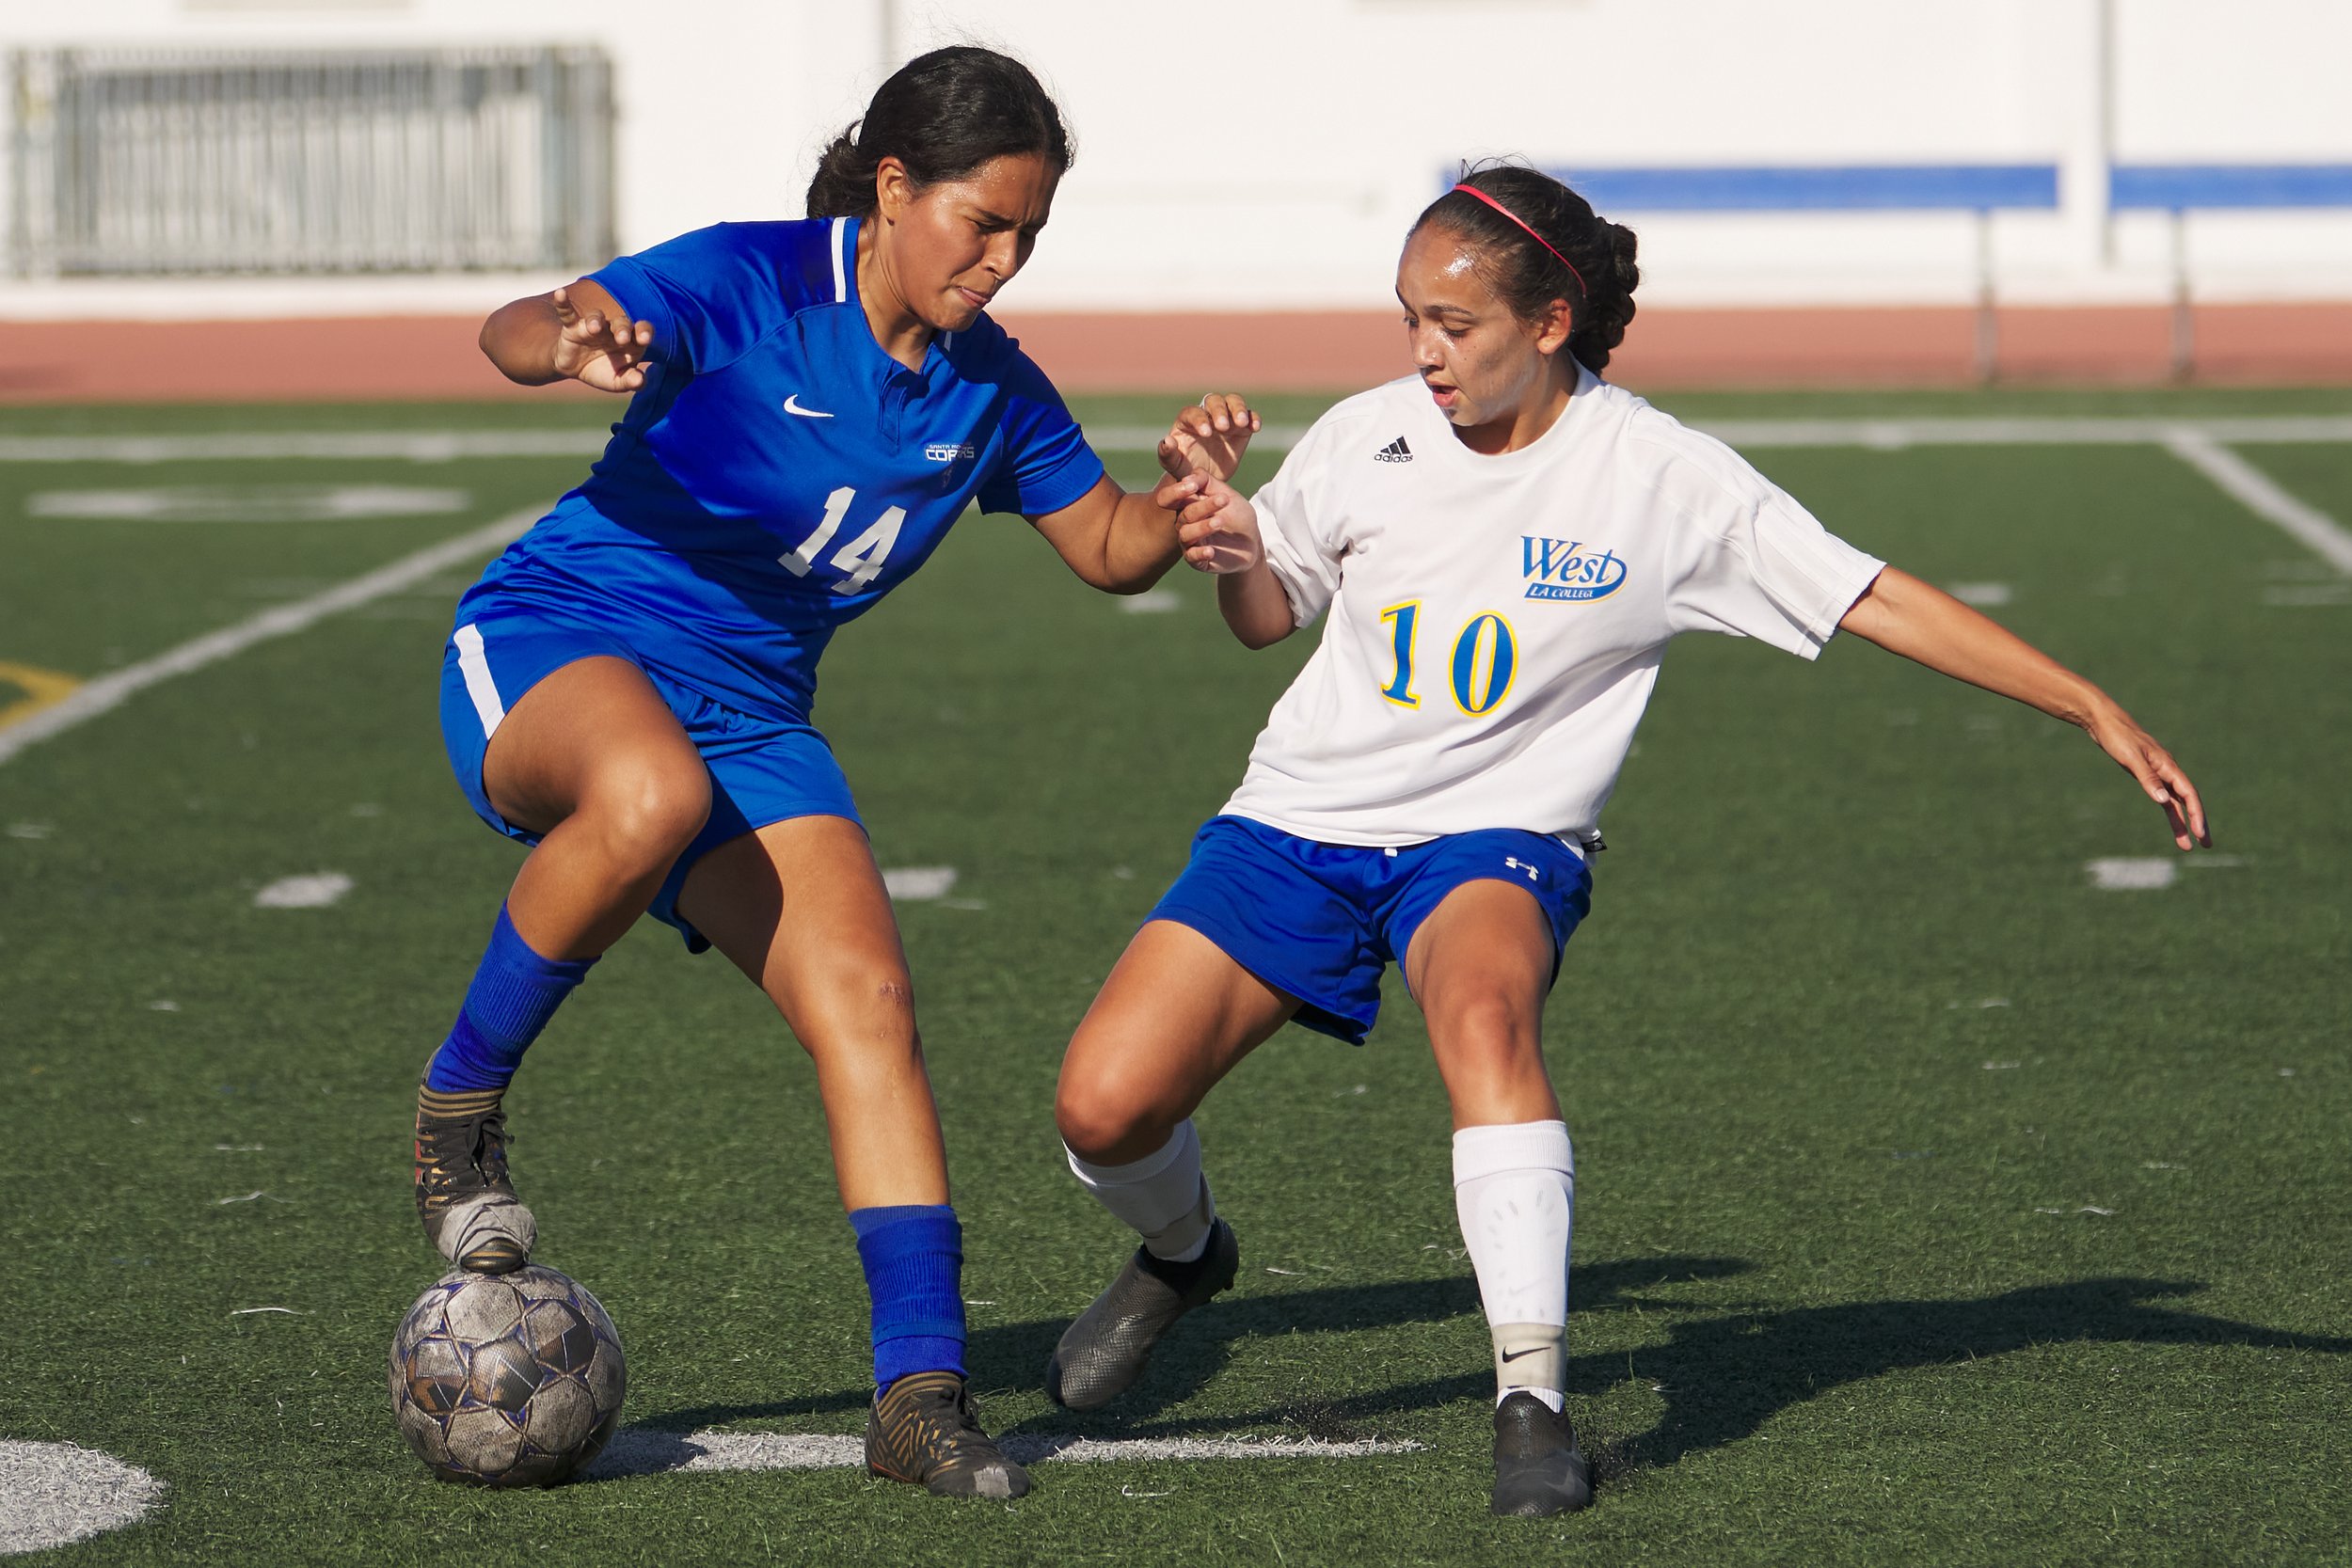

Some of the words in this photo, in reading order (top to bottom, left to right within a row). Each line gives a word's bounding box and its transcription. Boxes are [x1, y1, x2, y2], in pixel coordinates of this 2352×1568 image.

[1374, 452, 1413, 463] adidas
[777, 485, 906, 595] 14
[1520, 535, 1622, 584] West
[1530, 586, 1549, 597] LA
[1552, 587, 1595, 598] COLLEGE
[1380, 598, 1518, 719] 10
